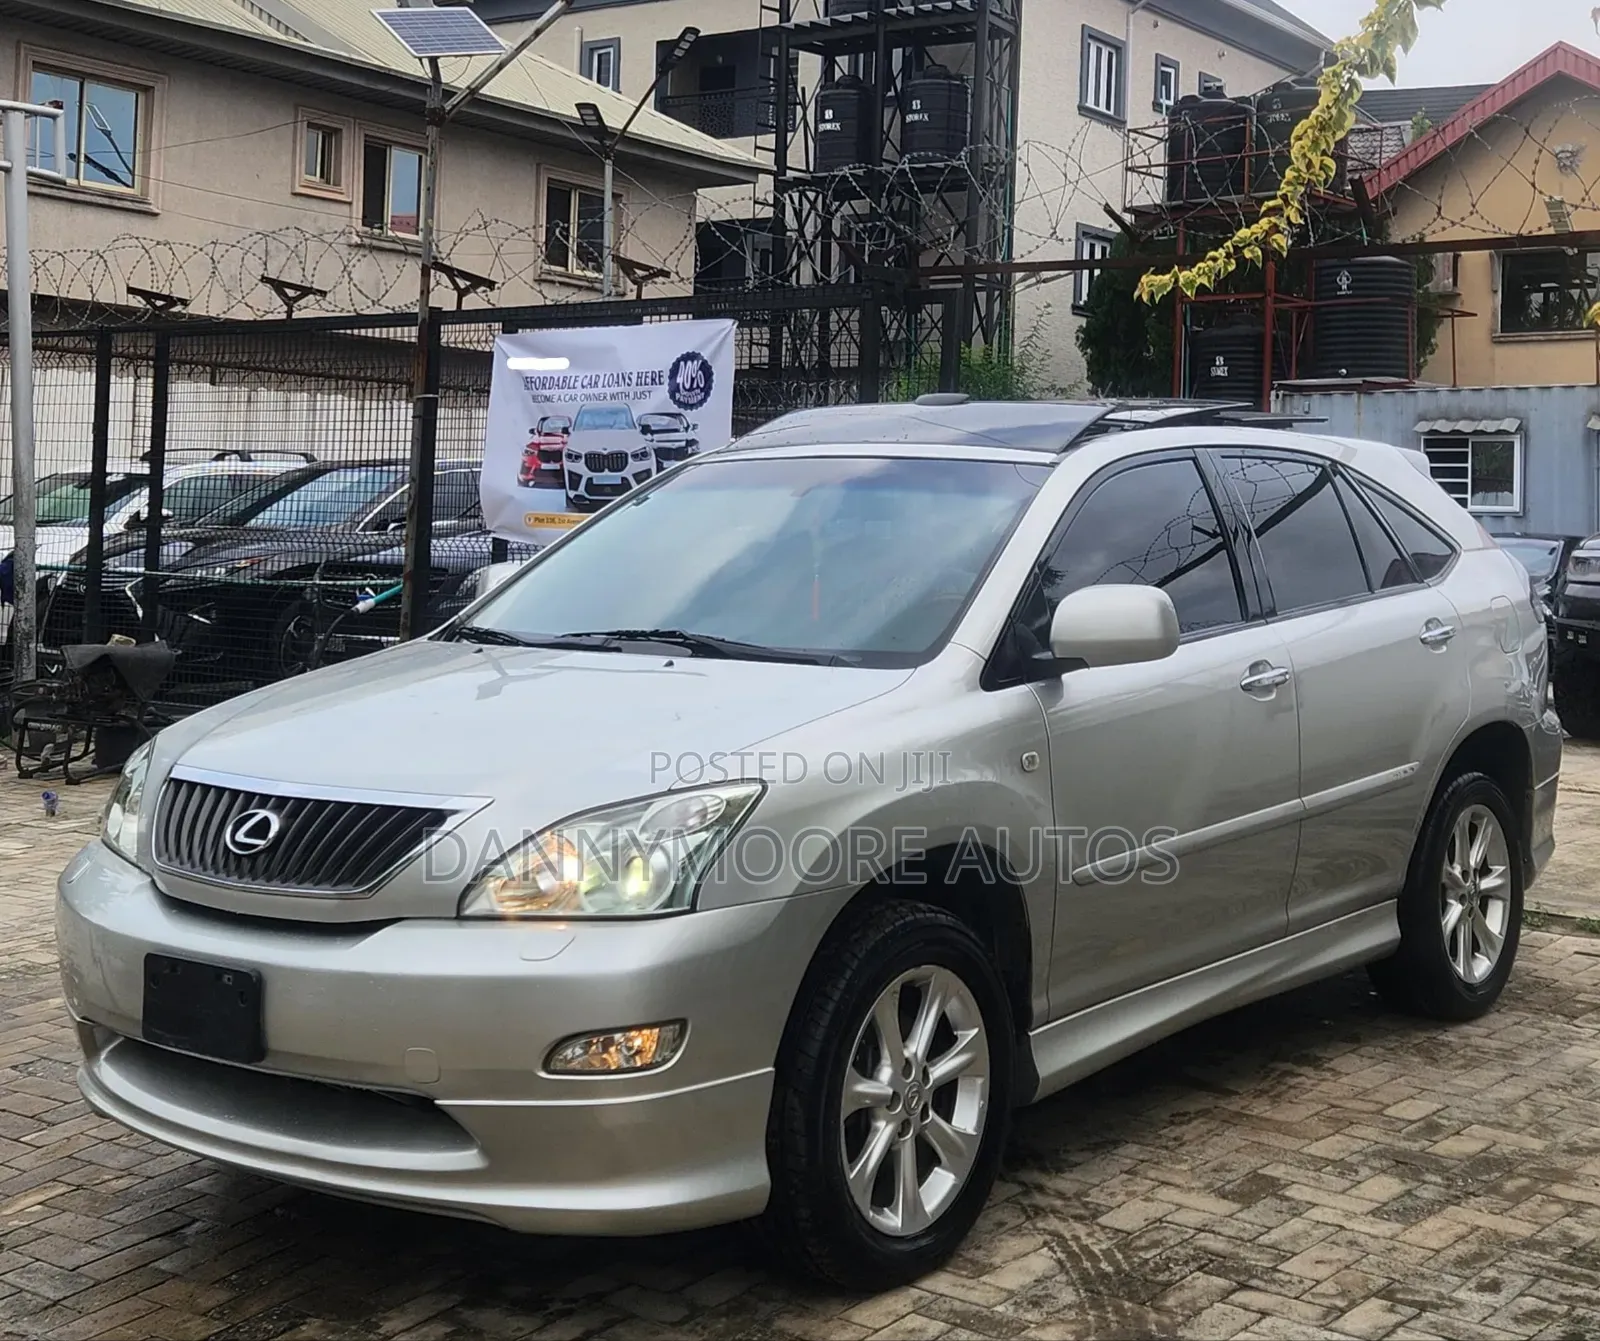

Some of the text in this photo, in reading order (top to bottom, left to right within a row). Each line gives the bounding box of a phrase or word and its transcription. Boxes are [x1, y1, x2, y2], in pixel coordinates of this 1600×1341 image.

[580, 374, 601, 389] CAR
[601, 371, 633, 388] LOANS
[635, 370, 665, 387] HERE
[676, 359, 705, 390] 40%
[556, 394, 563, 403] A
[563, 393, 579, 403] CAR
[579, 392, 608, 403] OWNER
[609, 391, 631, 401] WITH
[632, 390, 653, 400] JUST
